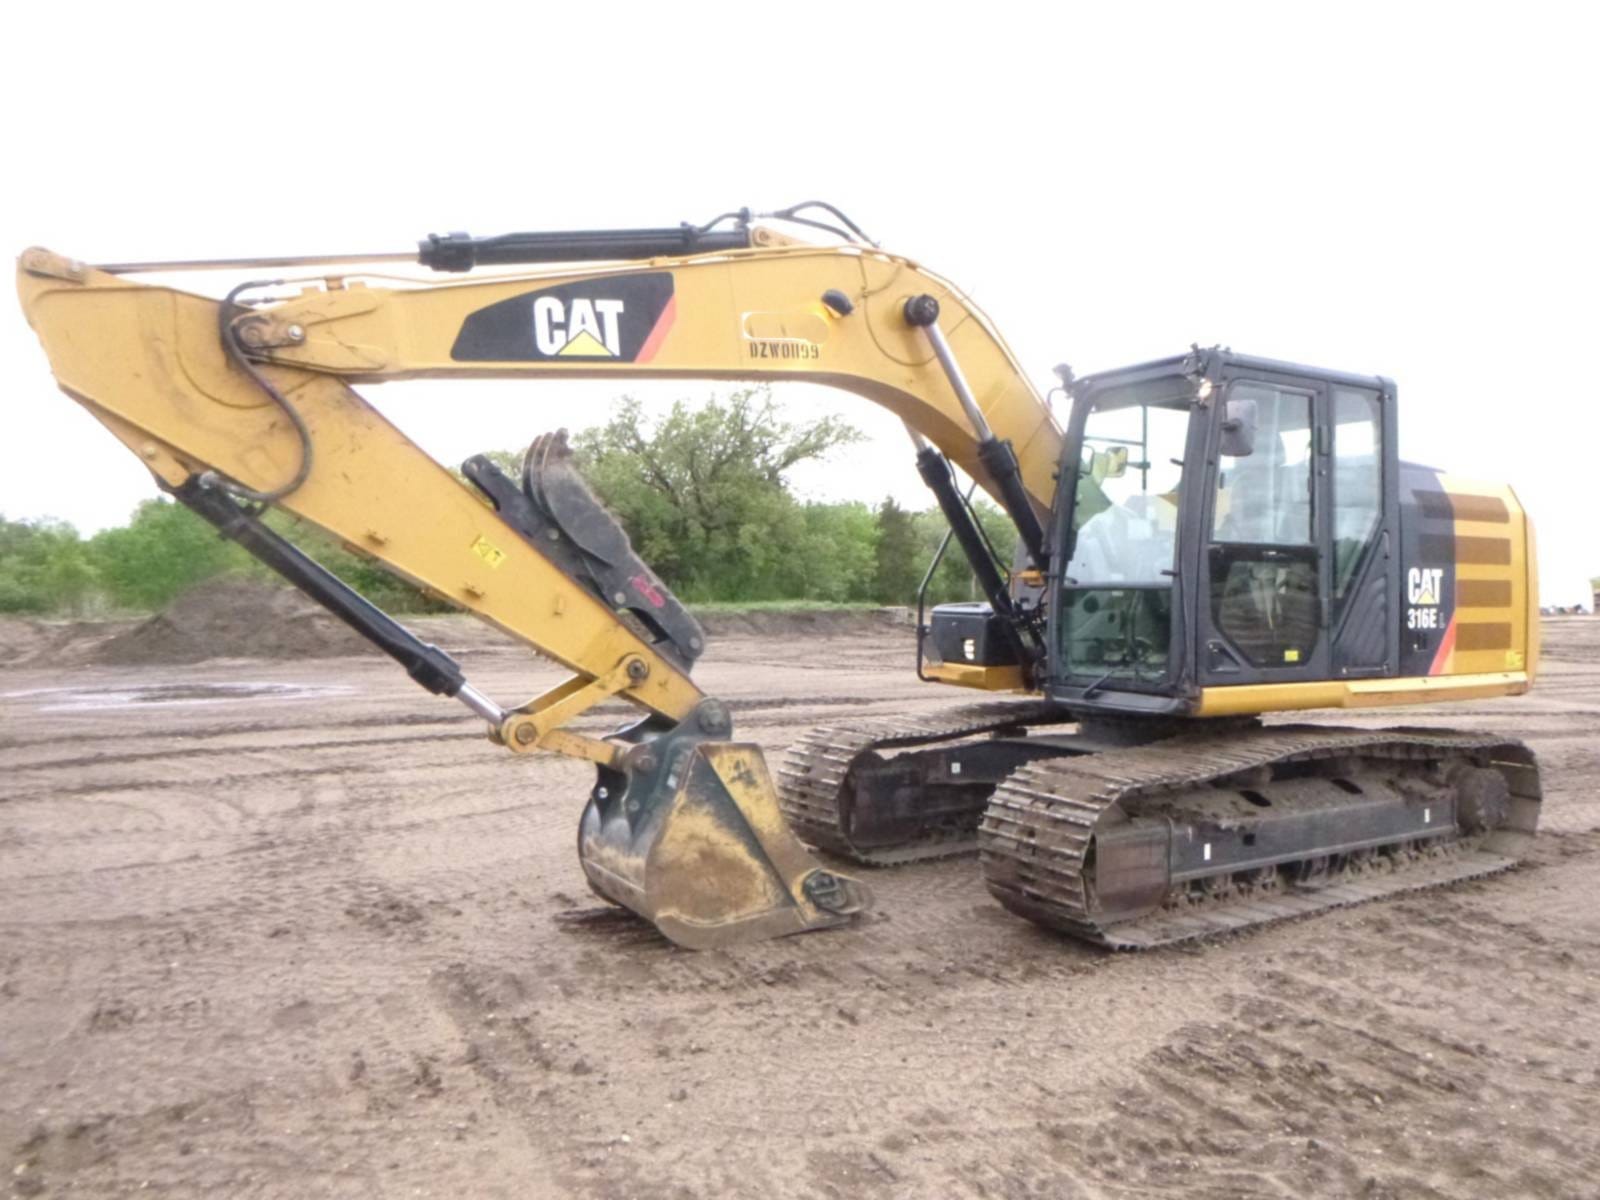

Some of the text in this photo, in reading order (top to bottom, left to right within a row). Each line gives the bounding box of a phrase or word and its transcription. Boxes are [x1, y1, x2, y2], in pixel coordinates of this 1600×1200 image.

[533, 295, 624, 357] CAT
[1407, 567, 1443, 605] CAT
[1407, 607, 1438, 629] 316E
